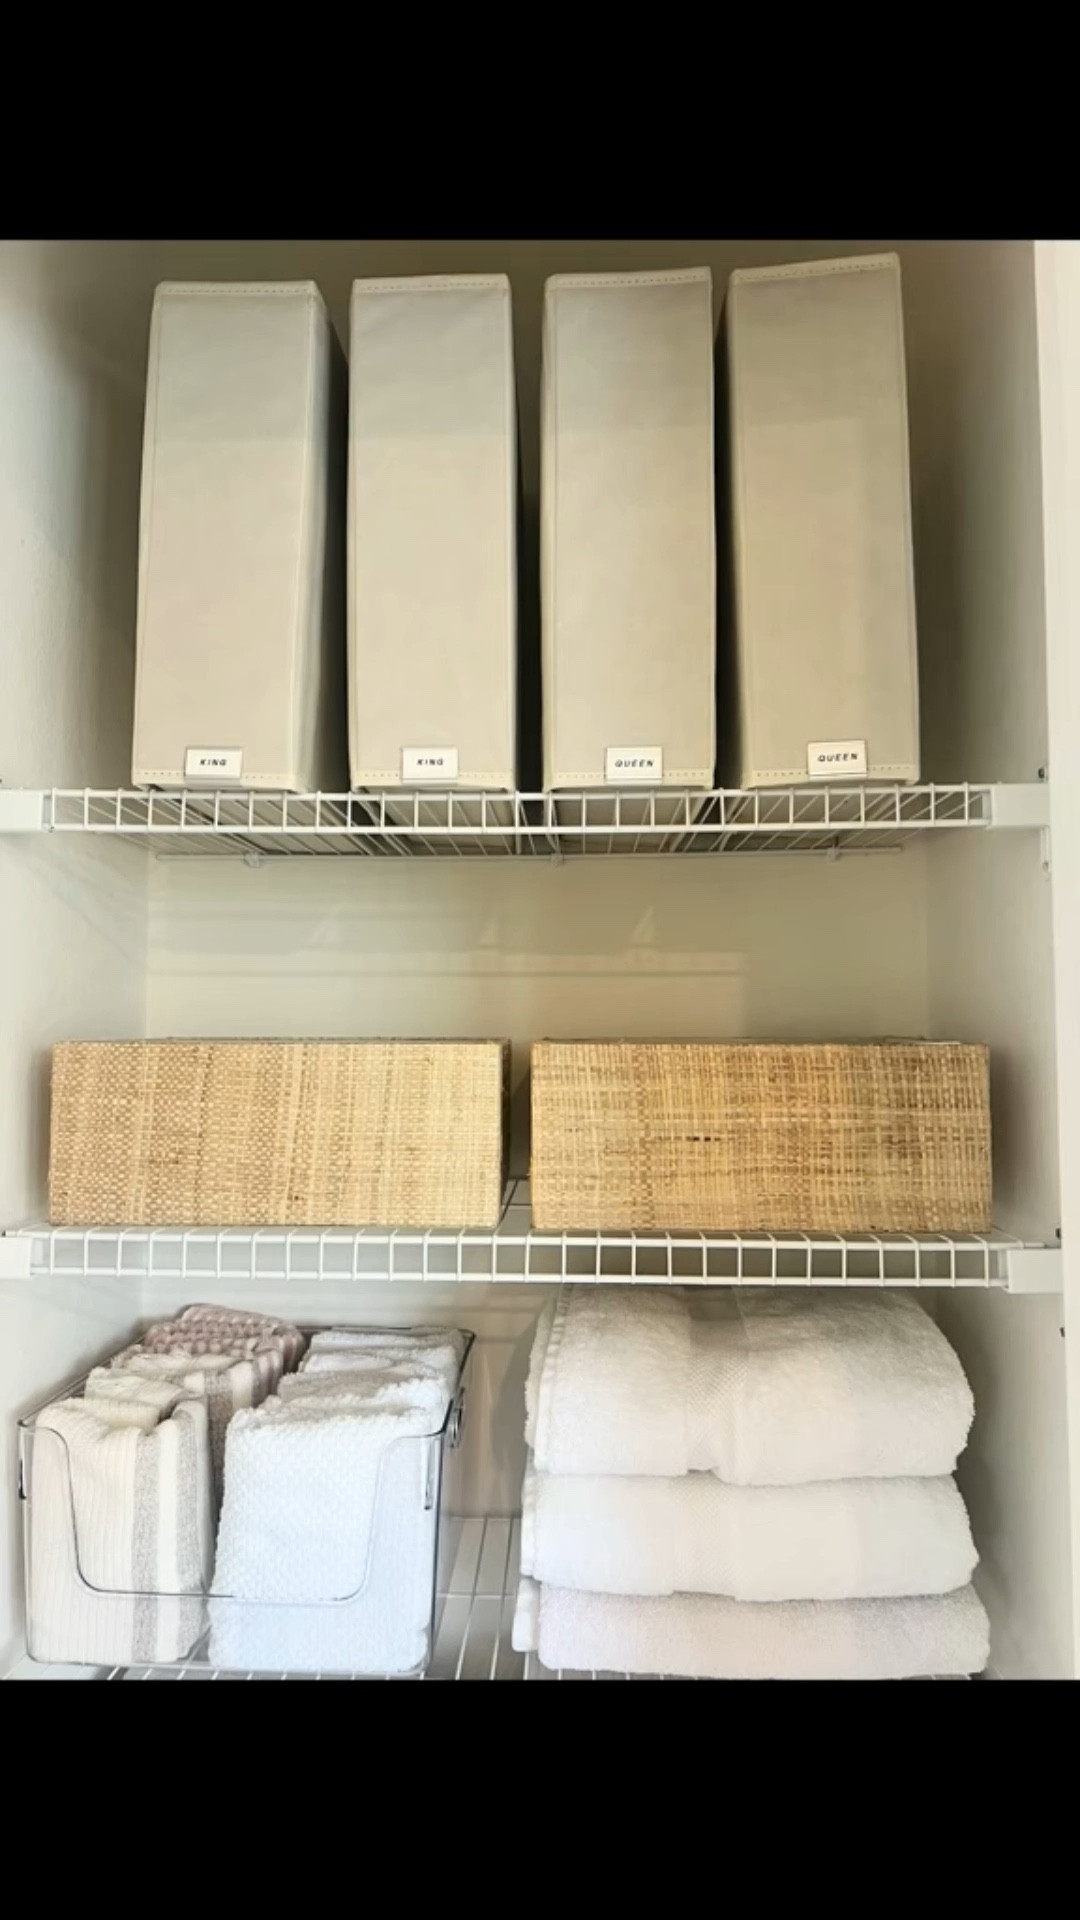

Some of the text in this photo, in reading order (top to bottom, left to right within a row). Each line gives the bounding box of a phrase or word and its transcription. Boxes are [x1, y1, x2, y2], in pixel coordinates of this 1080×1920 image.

[817, 752, 859, 762] QUEEN
[199, 758, 228, 767] KING
[416, 758, 445, 767] KING
[614, 758, 655, 768] QUEEN
